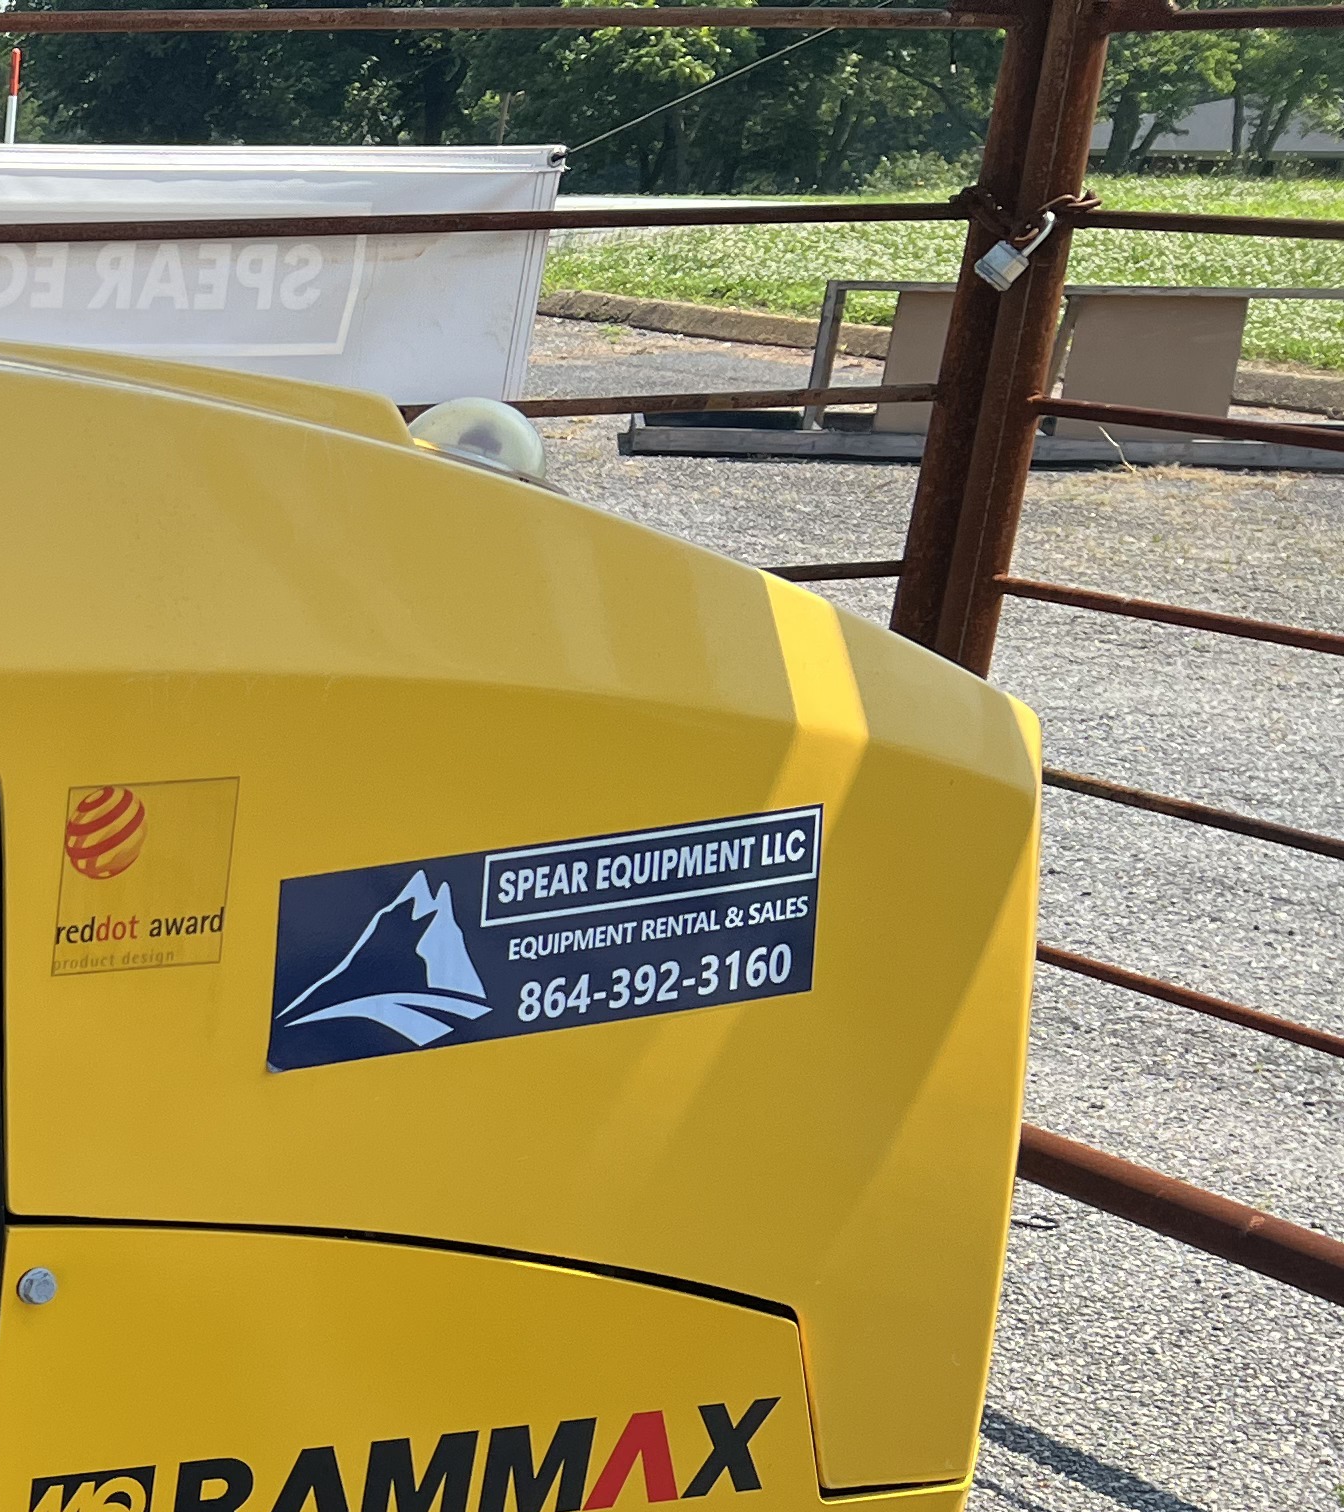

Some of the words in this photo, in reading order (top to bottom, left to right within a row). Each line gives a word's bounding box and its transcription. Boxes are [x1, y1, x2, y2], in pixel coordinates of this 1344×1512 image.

[497, 858, 590, 905] SPEAR
[595, 836, 756, 890] EQUIPMENT
[760, 829, 807, 867] LLC
[55, 914, 140, 945] reddot
[148, 905, 225, 938] award
[507, 920, 636, 962] EQUIPMENT
[640, 908, 720, 943] RENTAL
[723, 906, 745, 930] &
[748, 895, 810, 926] SALES
[53, 953, 115, 972] product
[121, 948, 175, 966] design
[516, 942, 793, 1023] 864-392-3160
